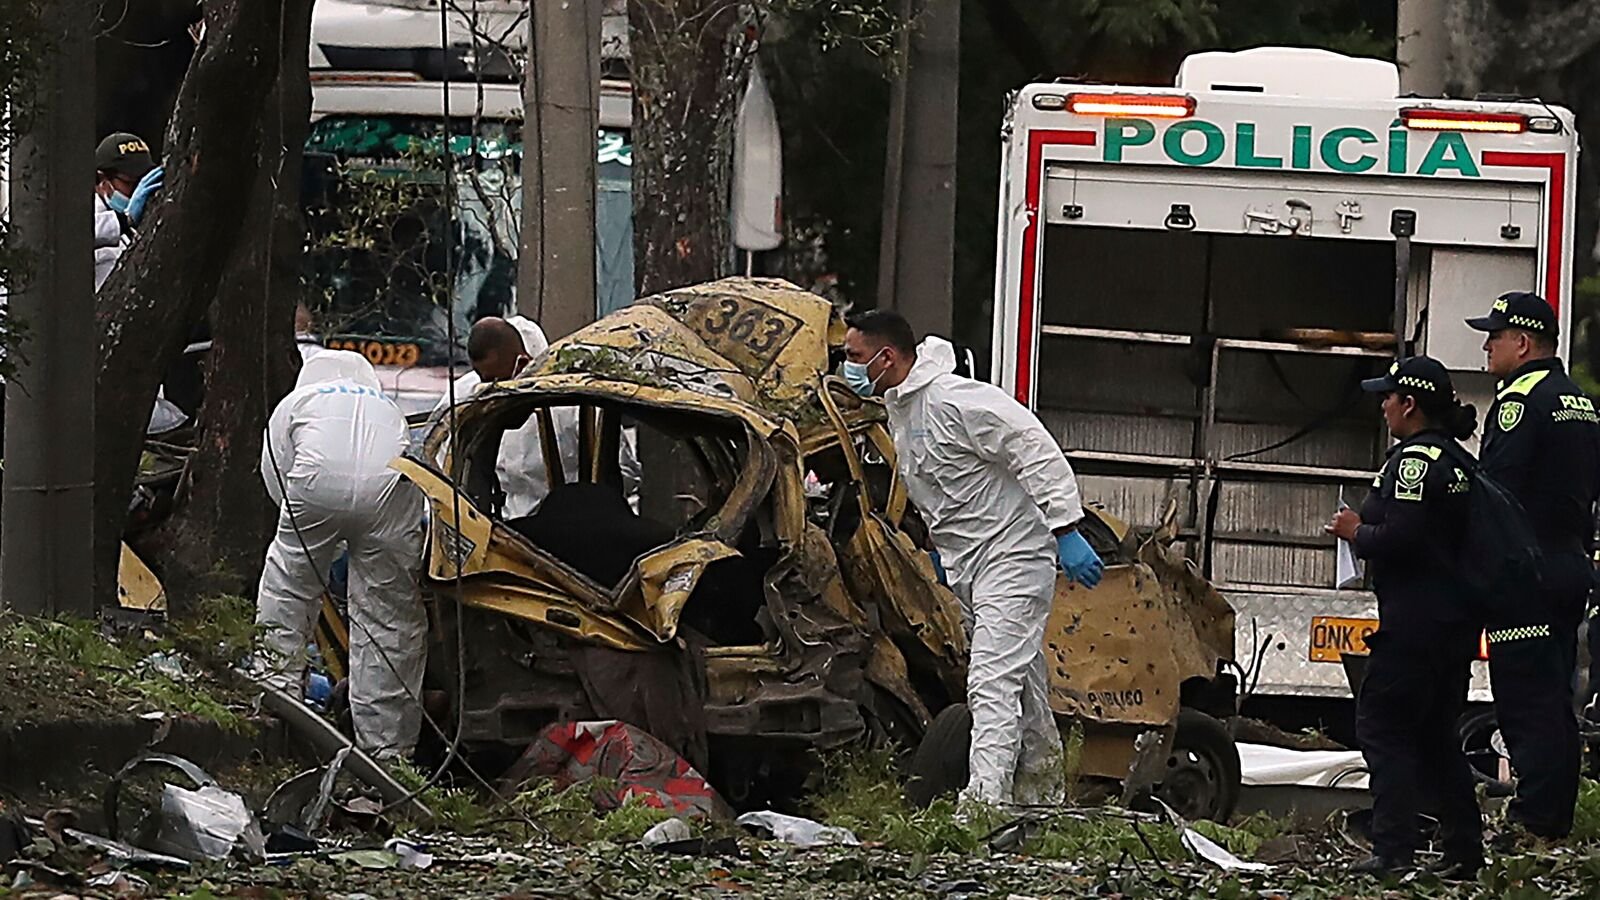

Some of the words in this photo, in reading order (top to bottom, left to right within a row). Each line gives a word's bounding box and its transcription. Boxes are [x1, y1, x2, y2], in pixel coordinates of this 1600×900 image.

[1103, 117, 1481, 177] POLICÍA
[706, 299, 785, 352] 363
[1314, 625, 1355, 651] ONK
